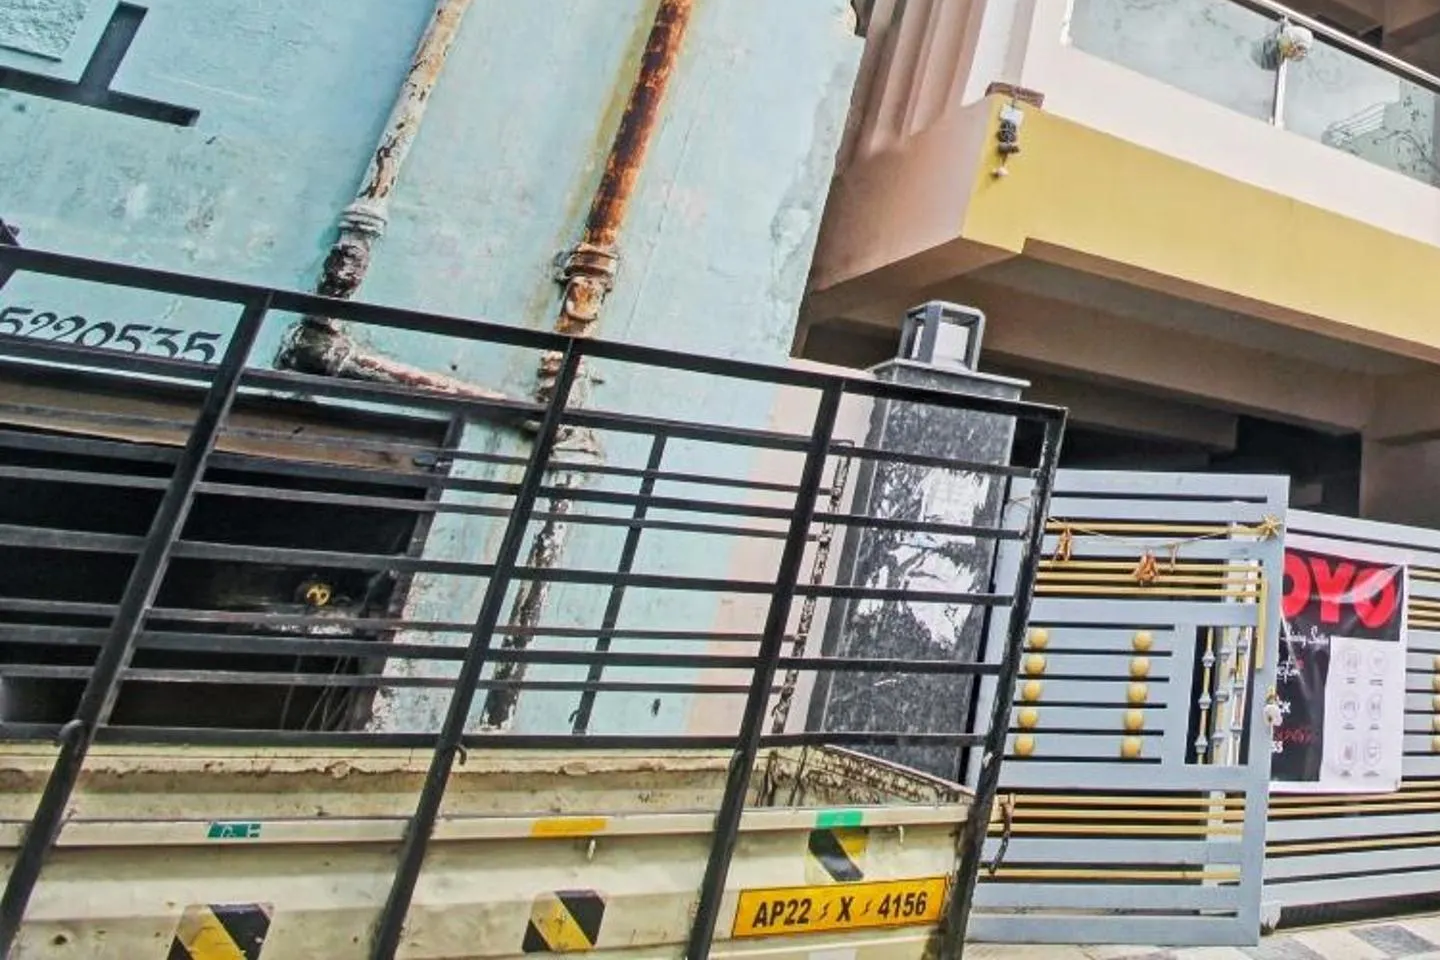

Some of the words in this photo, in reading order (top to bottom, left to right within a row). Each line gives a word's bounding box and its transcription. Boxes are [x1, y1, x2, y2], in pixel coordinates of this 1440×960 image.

[1281, 551, 1396, 629] OYO
[752, 898, 812, 928] AP22
[836, 896, 855, 922] X
[877, 890, 928, 918] 4156
